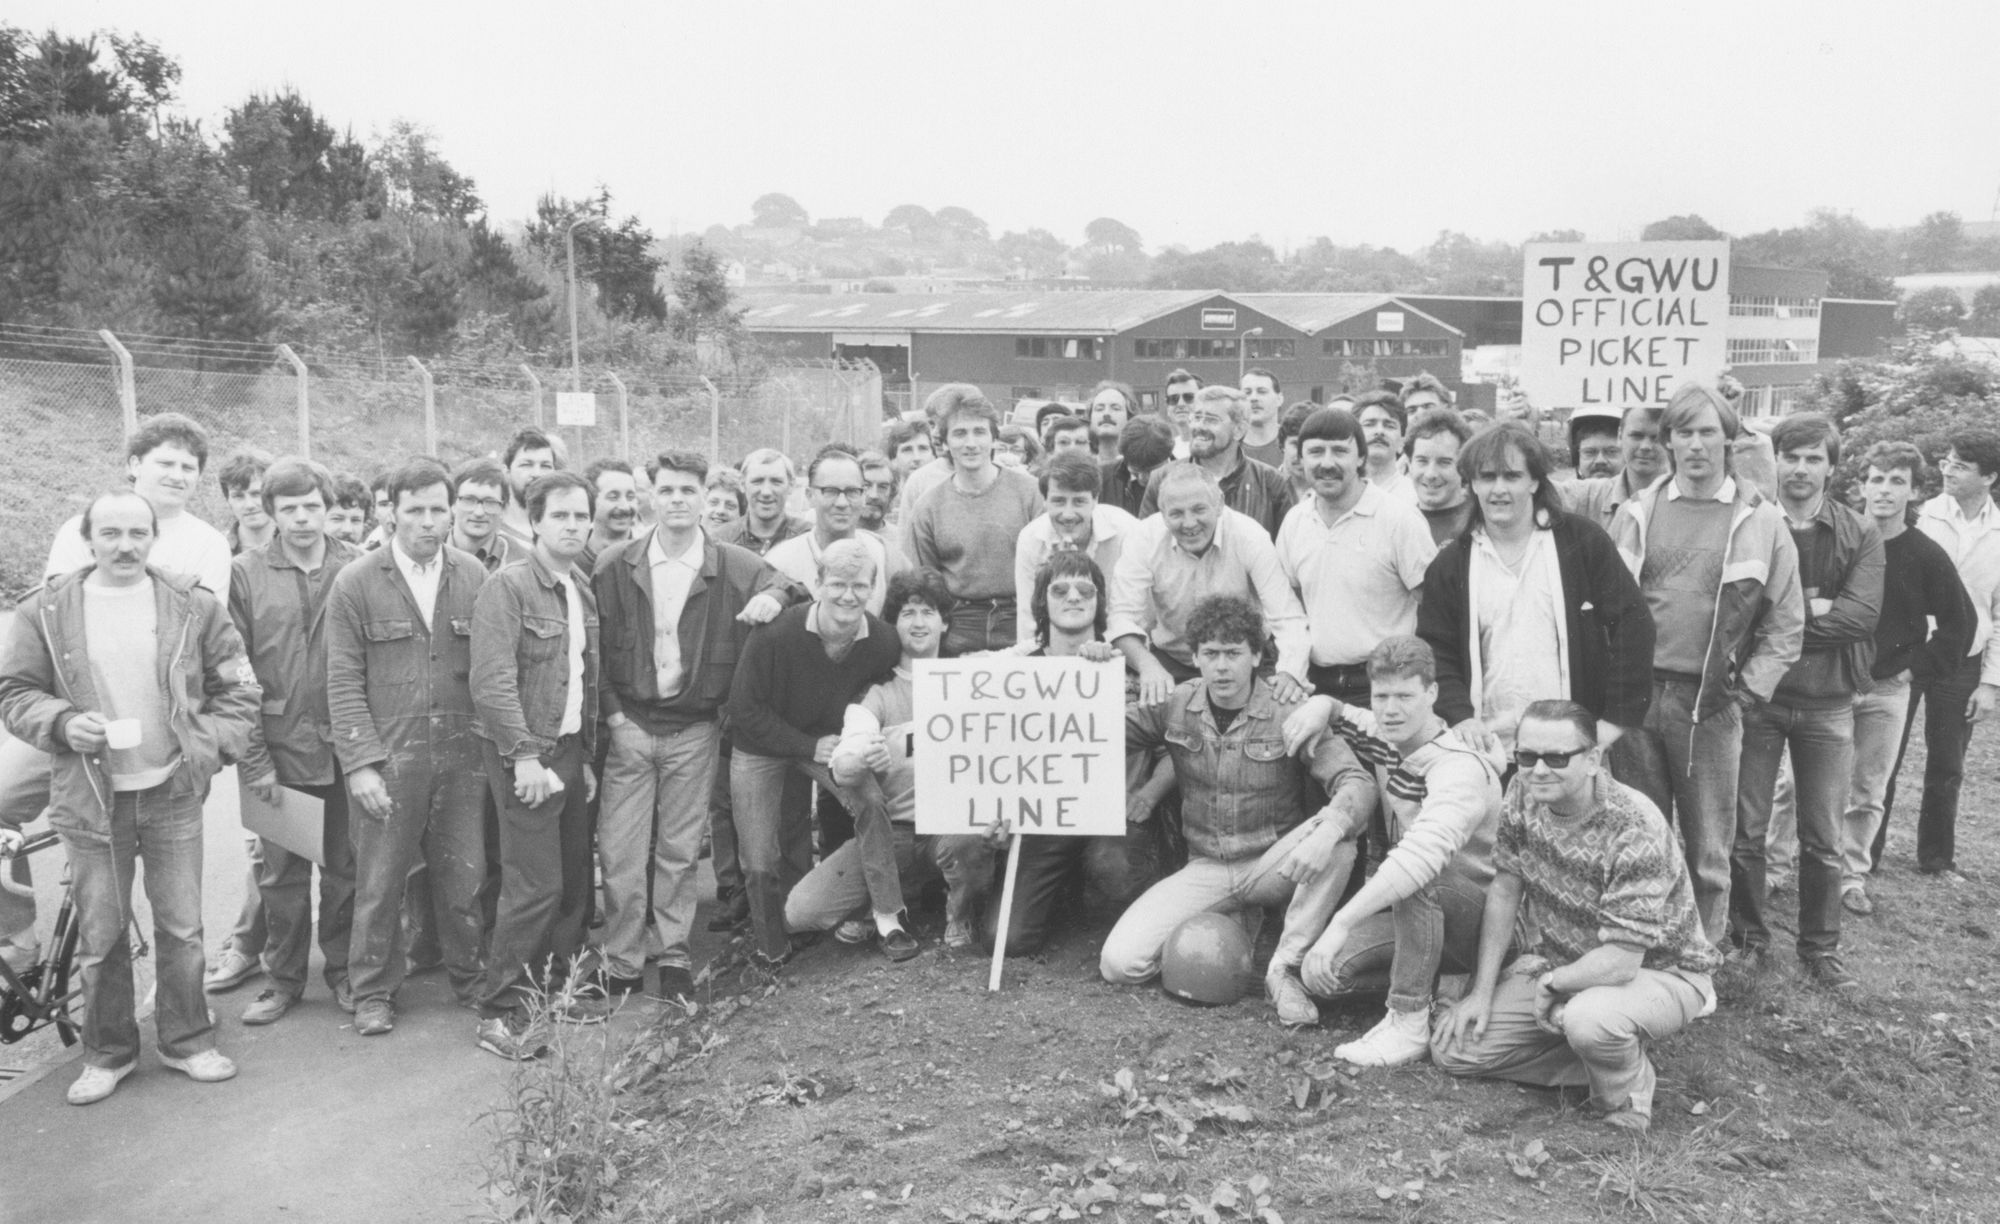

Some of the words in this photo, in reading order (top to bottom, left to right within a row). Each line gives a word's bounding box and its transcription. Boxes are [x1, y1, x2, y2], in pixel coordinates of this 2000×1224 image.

[1535, 297, 1709, 327] OFFICIAL
[1559, 335, 1700, 367] PICKET
[1581, 374, 1674, 403] LINE
[928, 670, 1100, 701] T&GWU
[926, 711, 1108, 743] OFFICIAL
[949, 753, 1101, 785] PICKET
[968, 796, 1079, 828] LINE
